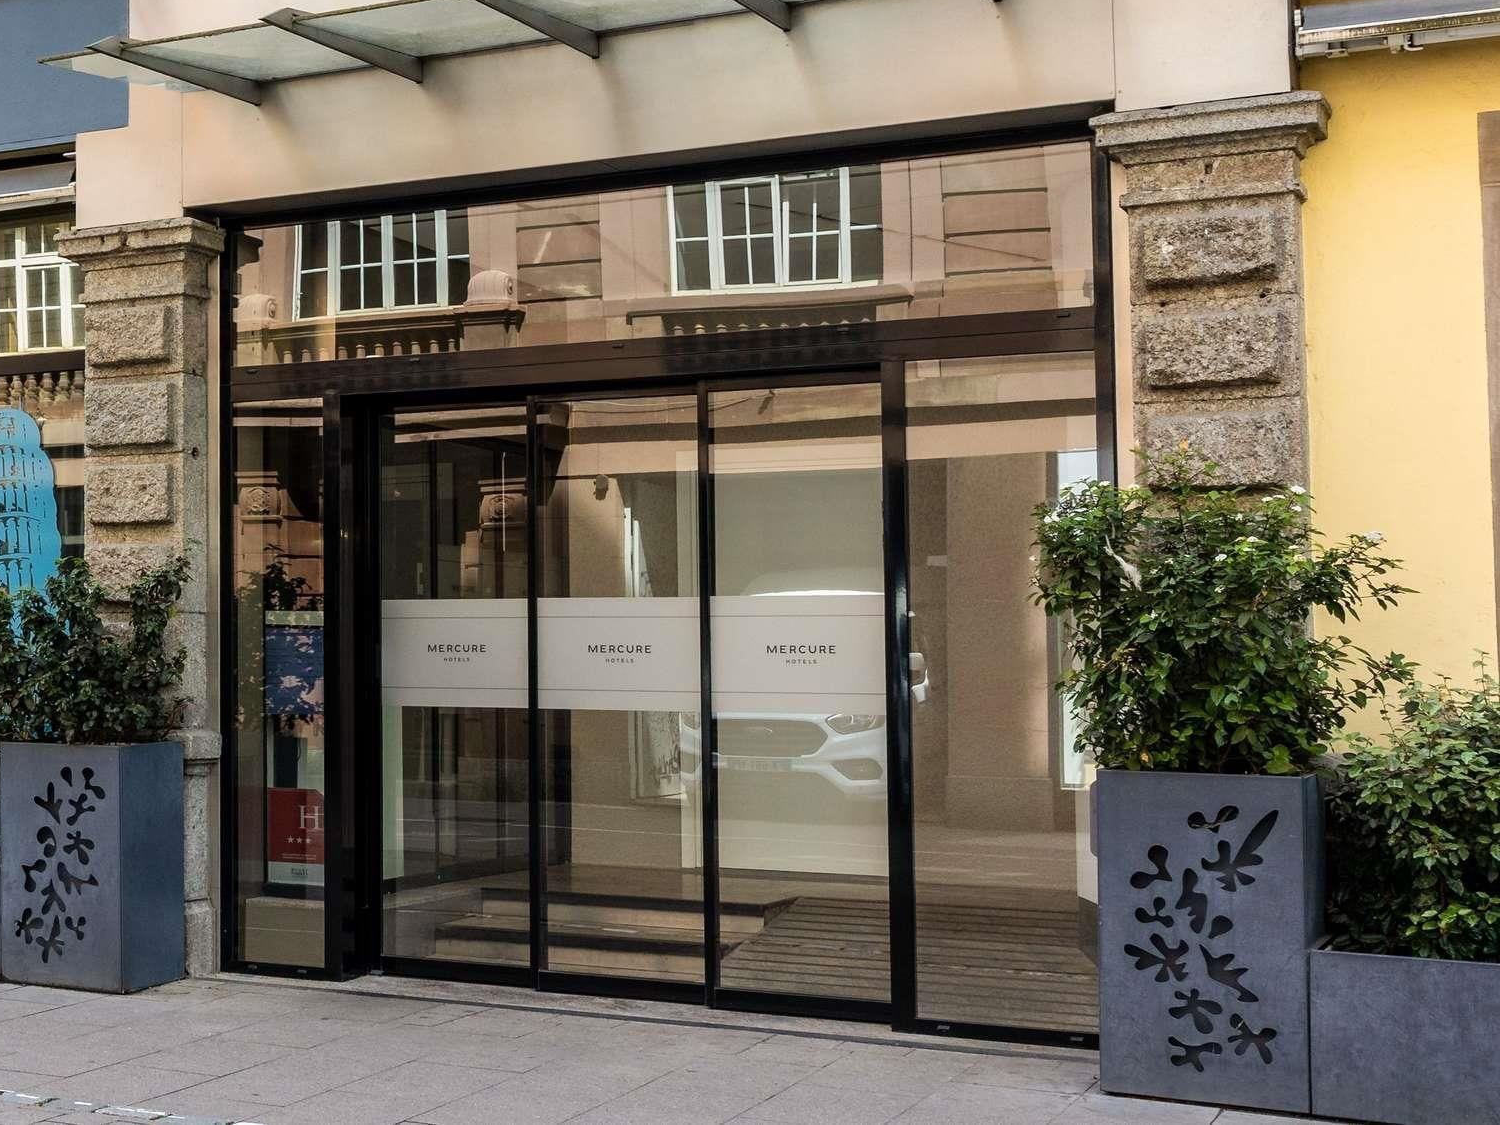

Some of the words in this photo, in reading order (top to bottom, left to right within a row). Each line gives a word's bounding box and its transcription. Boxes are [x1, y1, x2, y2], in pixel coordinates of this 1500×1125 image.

[427, 644, 486, 653] MERCURE
[588, 644, 652, 654] MERCURE
[766, 645, 836, 654] MERCURE
